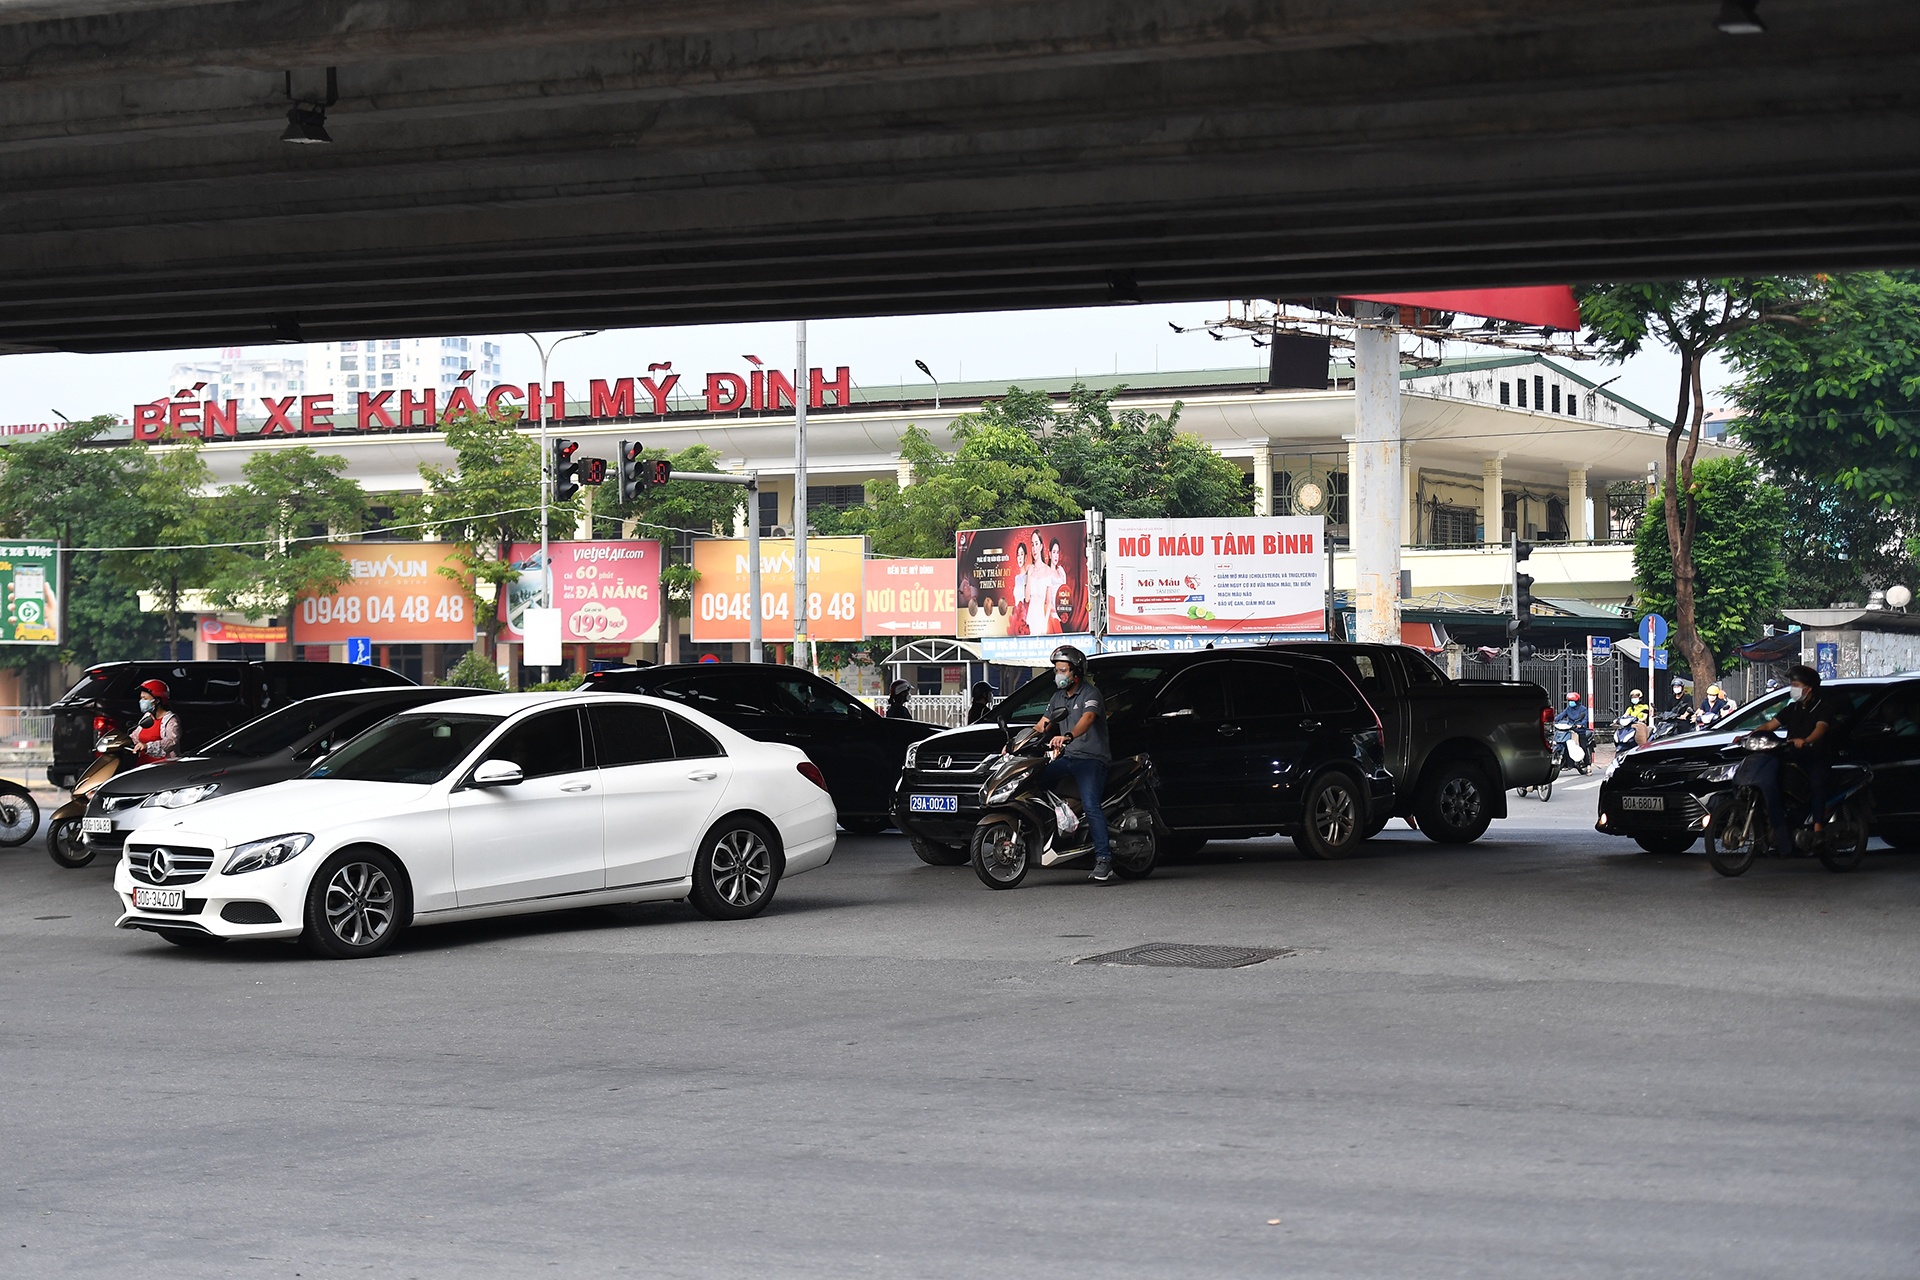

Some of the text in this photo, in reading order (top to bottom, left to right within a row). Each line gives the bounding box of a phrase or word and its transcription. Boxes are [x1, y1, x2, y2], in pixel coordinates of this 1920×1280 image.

[134, 355, 850, 440] BẾN XE KHÁCH MỸ ĐÌNH
[1119, 530, 1313, 556] MỠ MÁU TÂM BÌNH
[576, 566, 597, 579] 60
[887, 564, 899, 574] BẾN
[900, 566, 908, 574] XE
[576, 582, 598, 599] ĐÀ
[602, 578, 648, 600] NẴNG
[1138, 578, 1180, 587] Mỡ Máu
[762, 592, 789, 620] 04
[827, 592, 855, 620] 48
[866, 582, 955, 612] NƠI GỬI XE
[304, 595, 464, 624] 0948 04 48 48
[573, 614, 608, 633] 199
[912, 797, 956, 810] 29A-002.13
[1624, 797, 1662, 809] 30A-680.71
[137, 890, 180, 907] 30G-342.07
